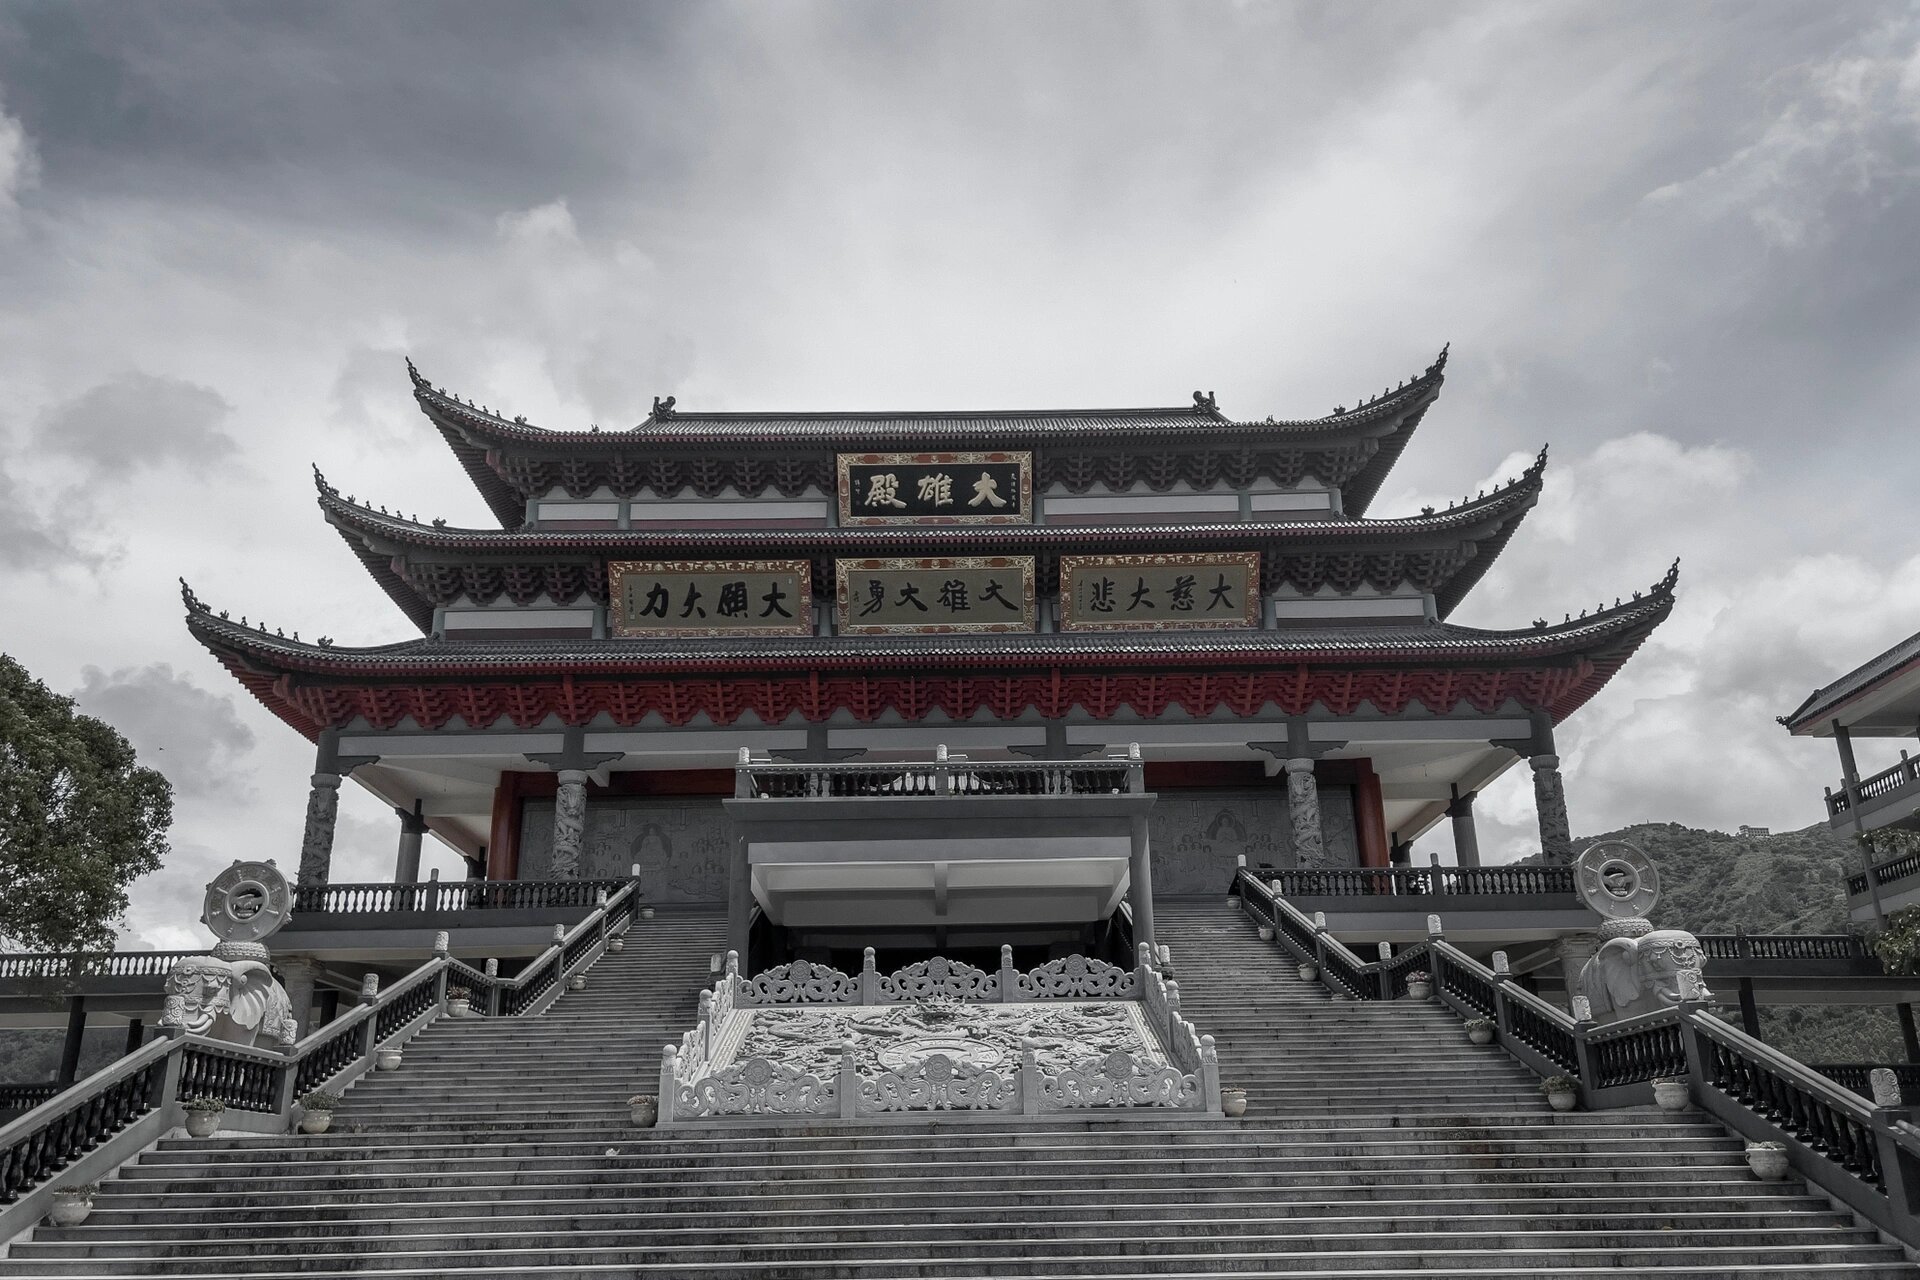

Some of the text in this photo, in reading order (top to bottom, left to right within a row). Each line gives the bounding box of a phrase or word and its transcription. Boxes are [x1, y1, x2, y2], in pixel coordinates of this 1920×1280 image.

[864, 471, 1007, 508] 大雄殿
[859, 579, 1019, 617] 大雄大勇
[1089, 573, 1235, 612] 大慈大悲
